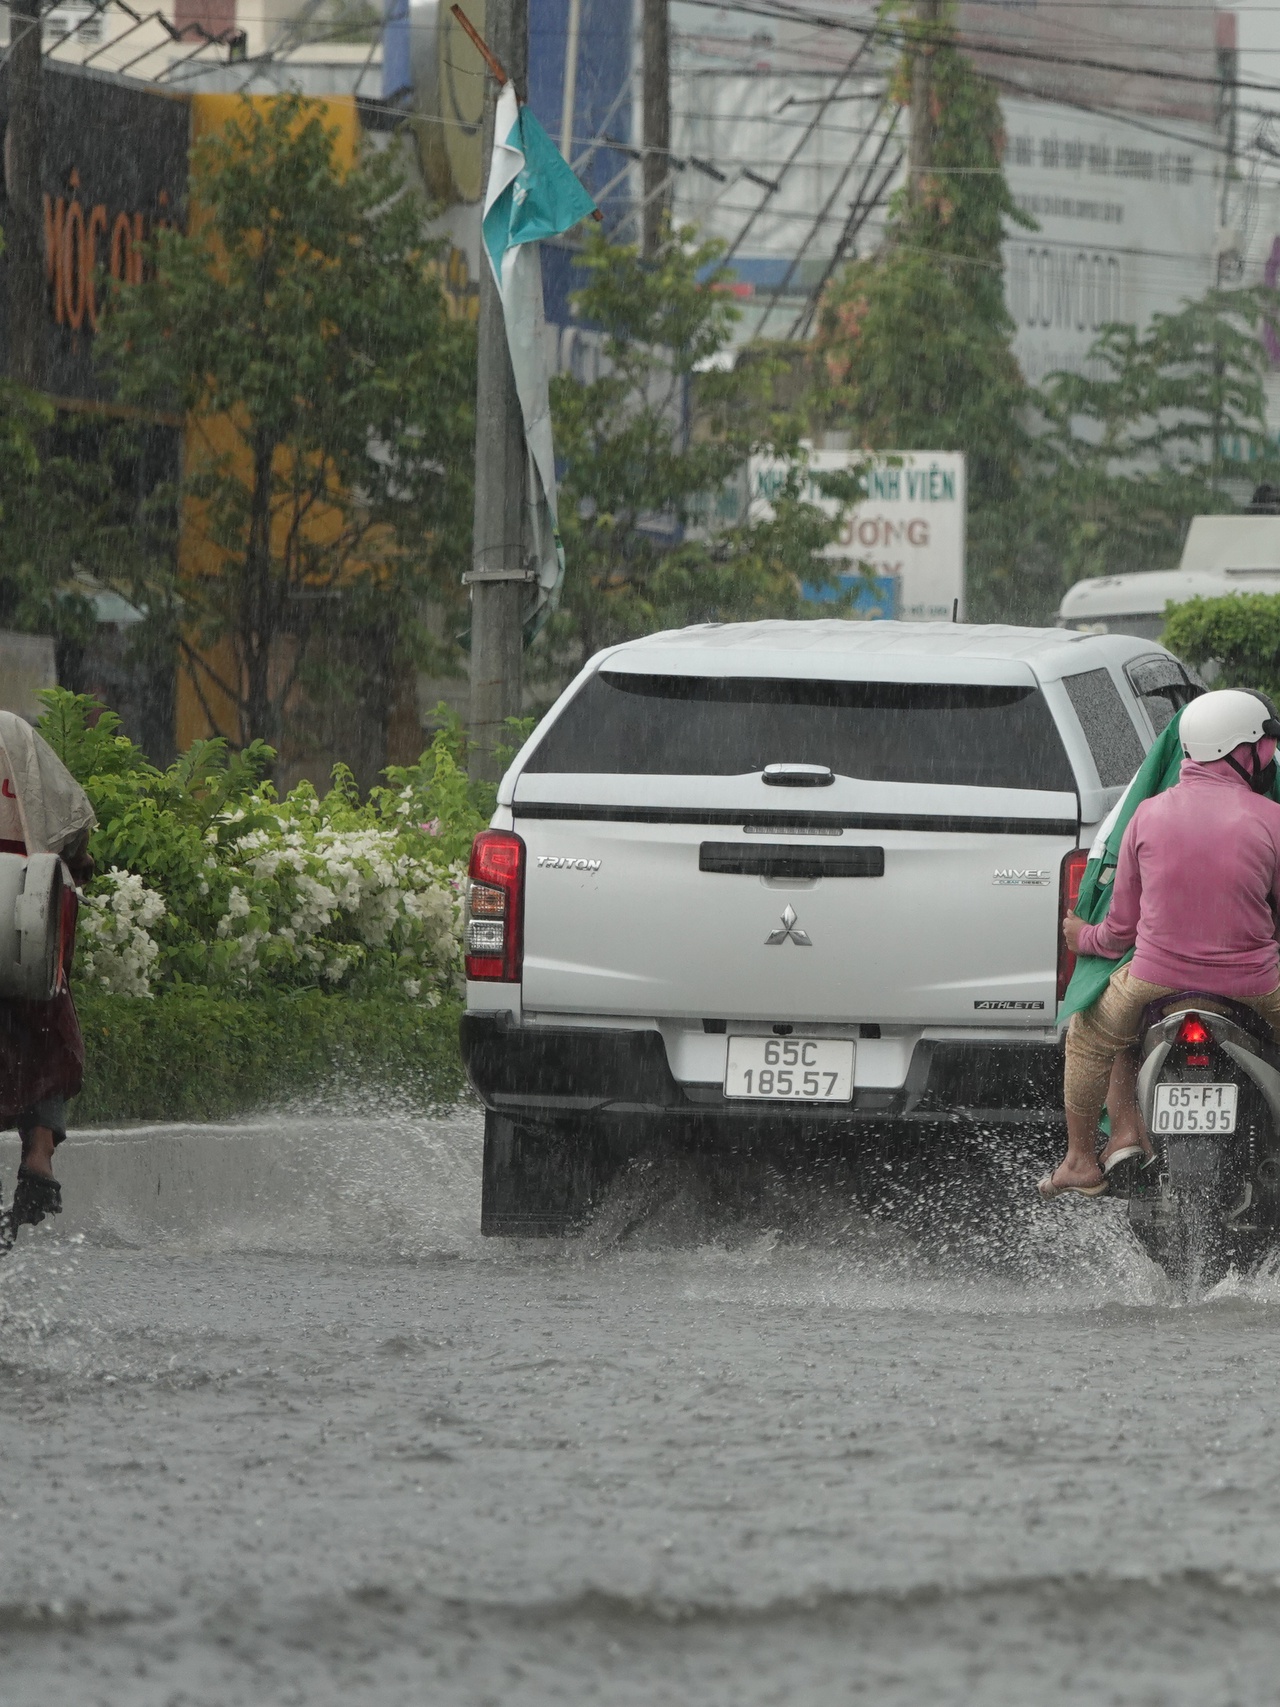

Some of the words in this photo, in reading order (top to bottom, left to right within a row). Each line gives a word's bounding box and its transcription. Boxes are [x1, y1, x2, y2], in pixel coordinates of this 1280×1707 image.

[905, 459, 956, 502] VIÊN
[537, 856, 602, 872] TRITON
[993, 869, 1051, 879] MIVEC
[976, 1001, 1043, 1010] ATHLETE
[764, 1040, 818, 1067] 65C
[743, 1069, 839, 1097] 185.57
[1168, 1087, 1223, 1107] 65-F1
[1158, 1110, 1231, 1130] 005.95
